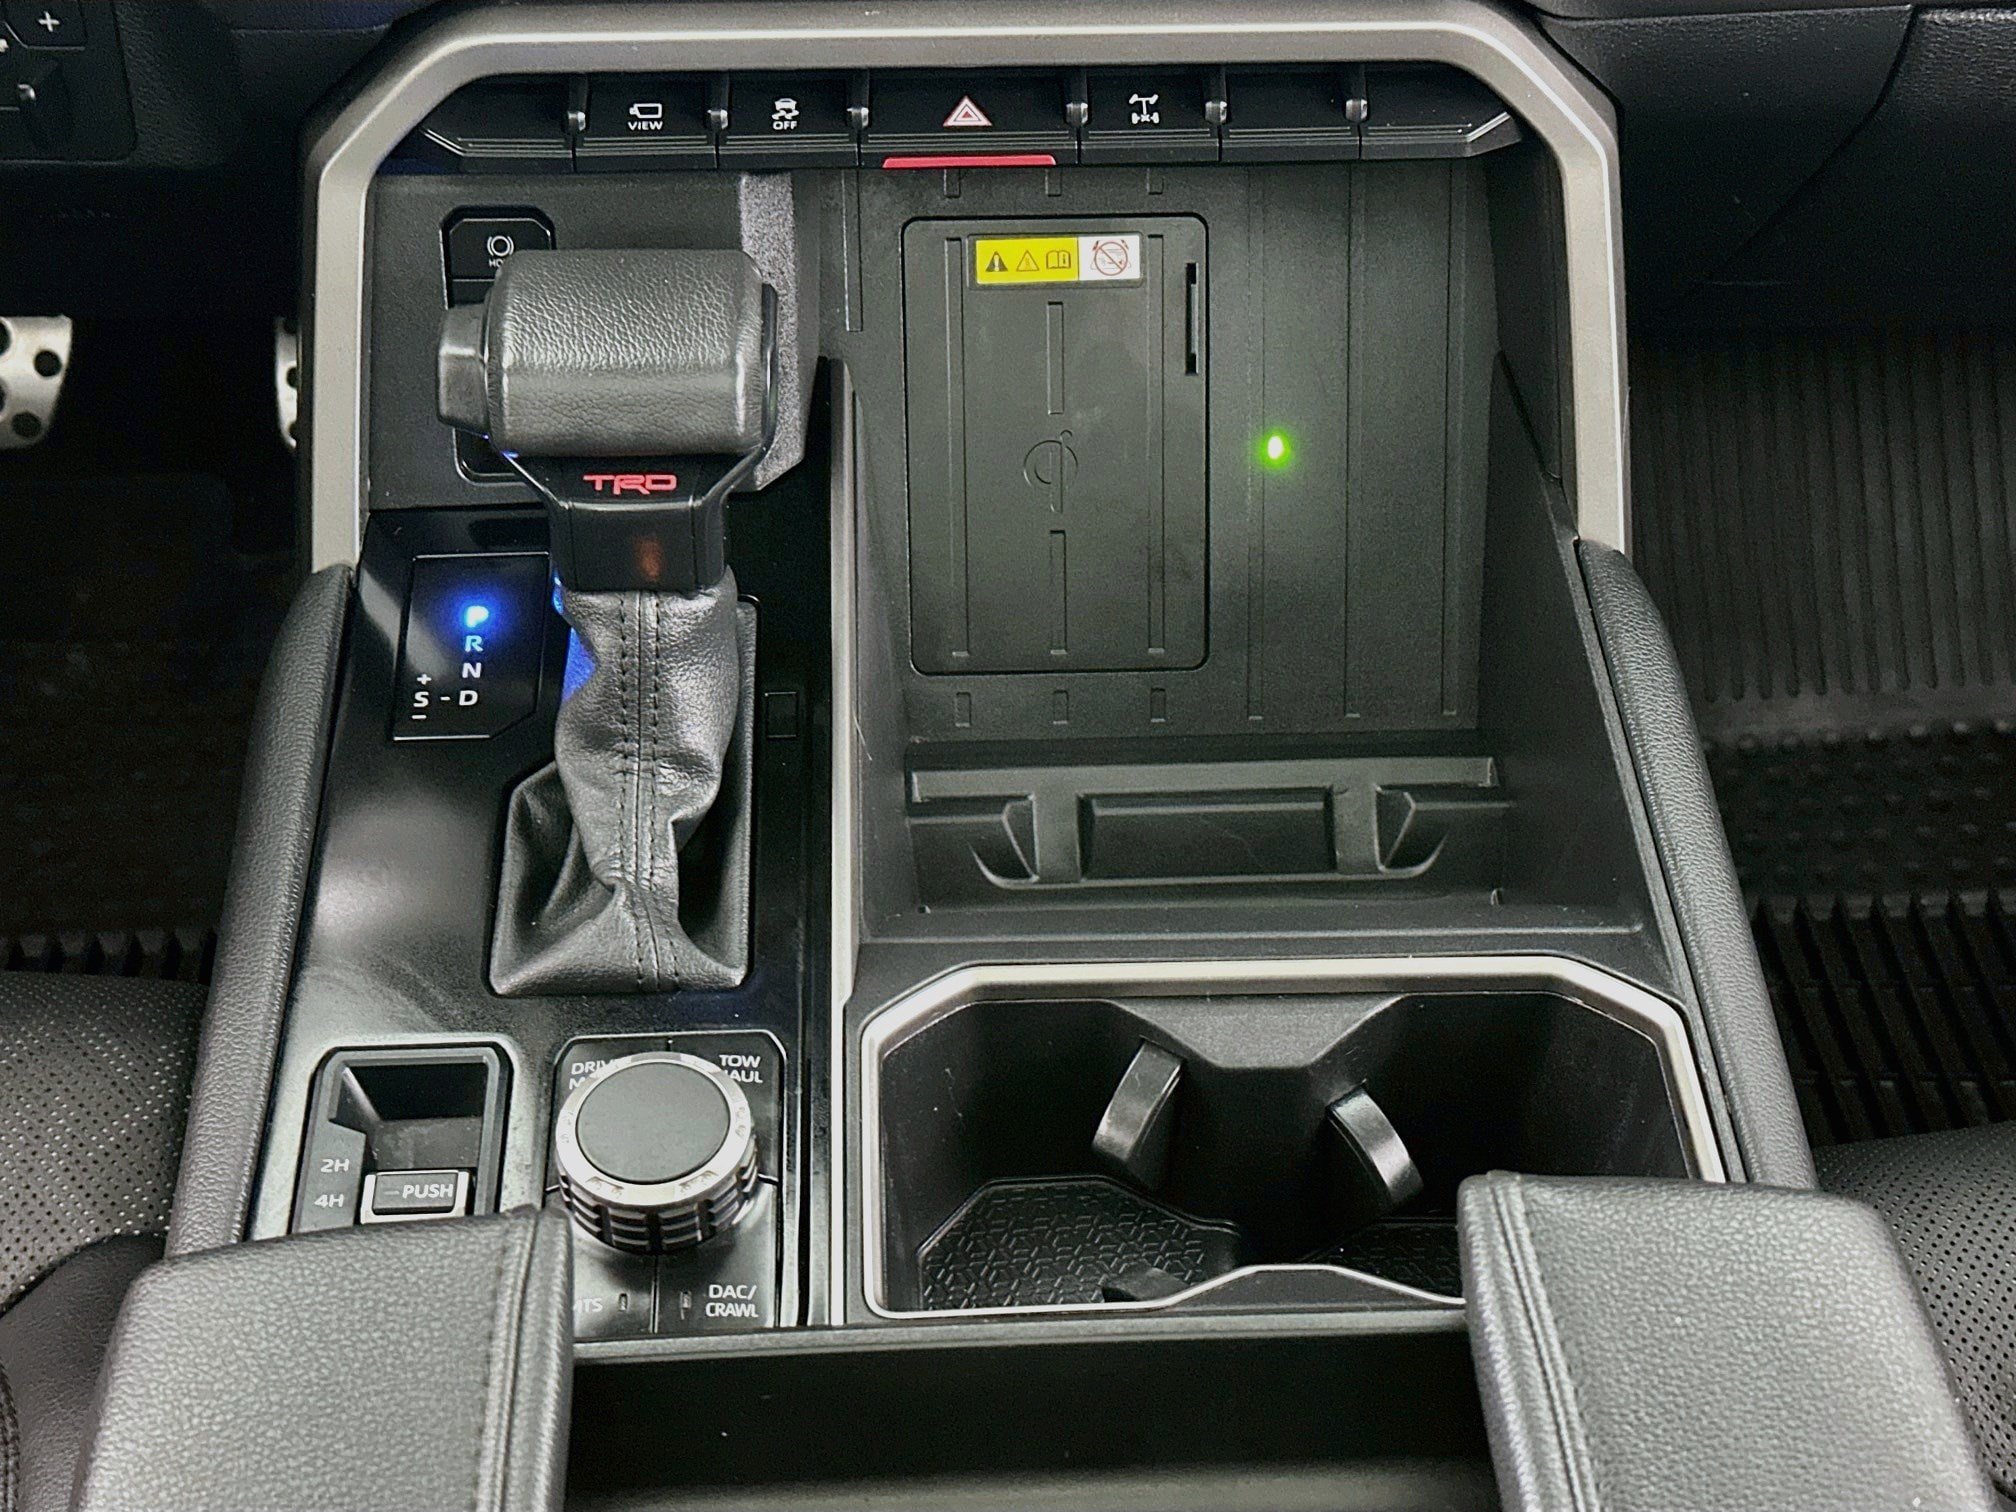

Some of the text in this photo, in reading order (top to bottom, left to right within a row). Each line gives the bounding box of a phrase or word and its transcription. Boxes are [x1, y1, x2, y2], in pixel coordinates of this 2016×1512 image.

[627, 120, 664, 131] VIEW
[772, 120, 798, 131] OFF
[488, 258, 504, 268] HO
[583, 474, 678, 495] TRD
[465, 605, 489, 628] P
[465, 635, 484, 653] R
[462, 662, 482, 679] N
[719, 1054, 761, 1068] TOW
[724, 1069, 764, 1084] AUL
[320, 1158, 350, 1173] 2H
[402, 1183, 454, 1199] PUSH
[314, 1193, 344, 1208] 4H
[708, 1284, 758, 1300] DAC/
[705, 1302, 759, 1318] CRAWL
